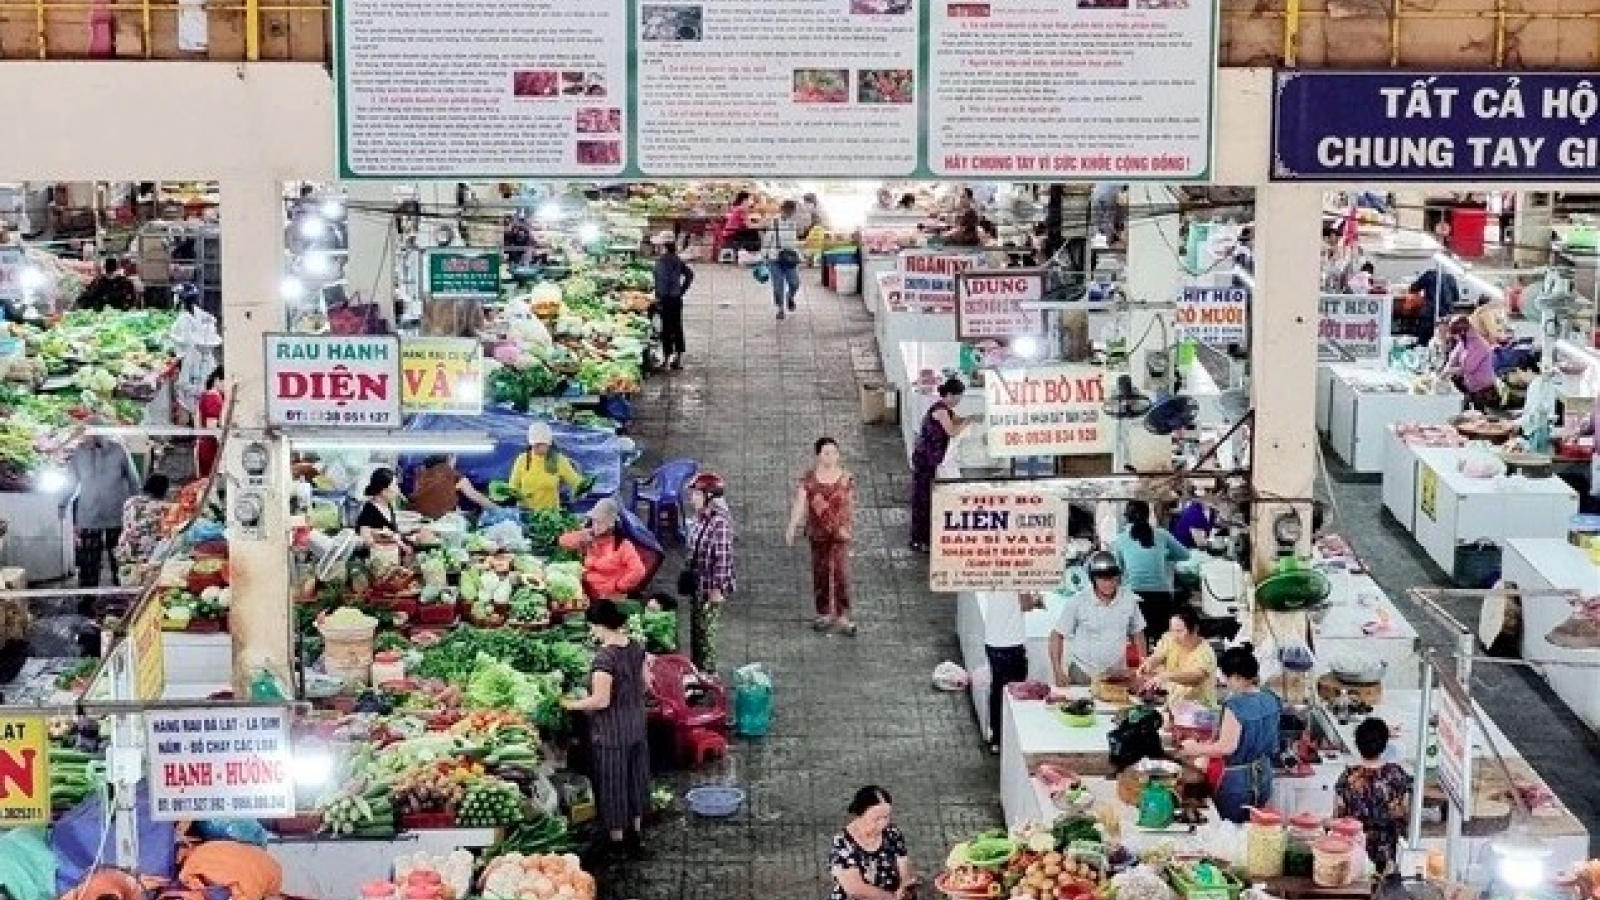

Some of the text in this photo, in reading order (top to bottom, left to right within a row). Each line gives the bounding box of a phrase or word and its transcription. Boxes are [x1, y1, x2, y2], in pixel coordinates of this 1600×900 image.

[1381, 76, 1599, 125] TẤT CẢ HỘ
[944, 153, 968, 170] HÃY
[972, 157, 1012, 170] CHUNG
[1016, 157, 1035, 169] TAY
[1115, 155, 1146, 172] CỘNG
[1317, 136, 1454, 168] CHUNG
[1466, 137, 1545, 167] TAY
[1346, 299, 1380, 315] HEO
[277, 343, 321, 360] RAU
[277, 364, 389, 406] DIỆN
[1044, 375, 1072, 403] BÒ
[960, 495, 1008, 507] THỊT
[943, 505, 1010, 531] LIÊN
[0, 722, 26, 741] ẠT
[183, 718, 202, 733] RAU
[164, 762, 213, 793] HẠNH
